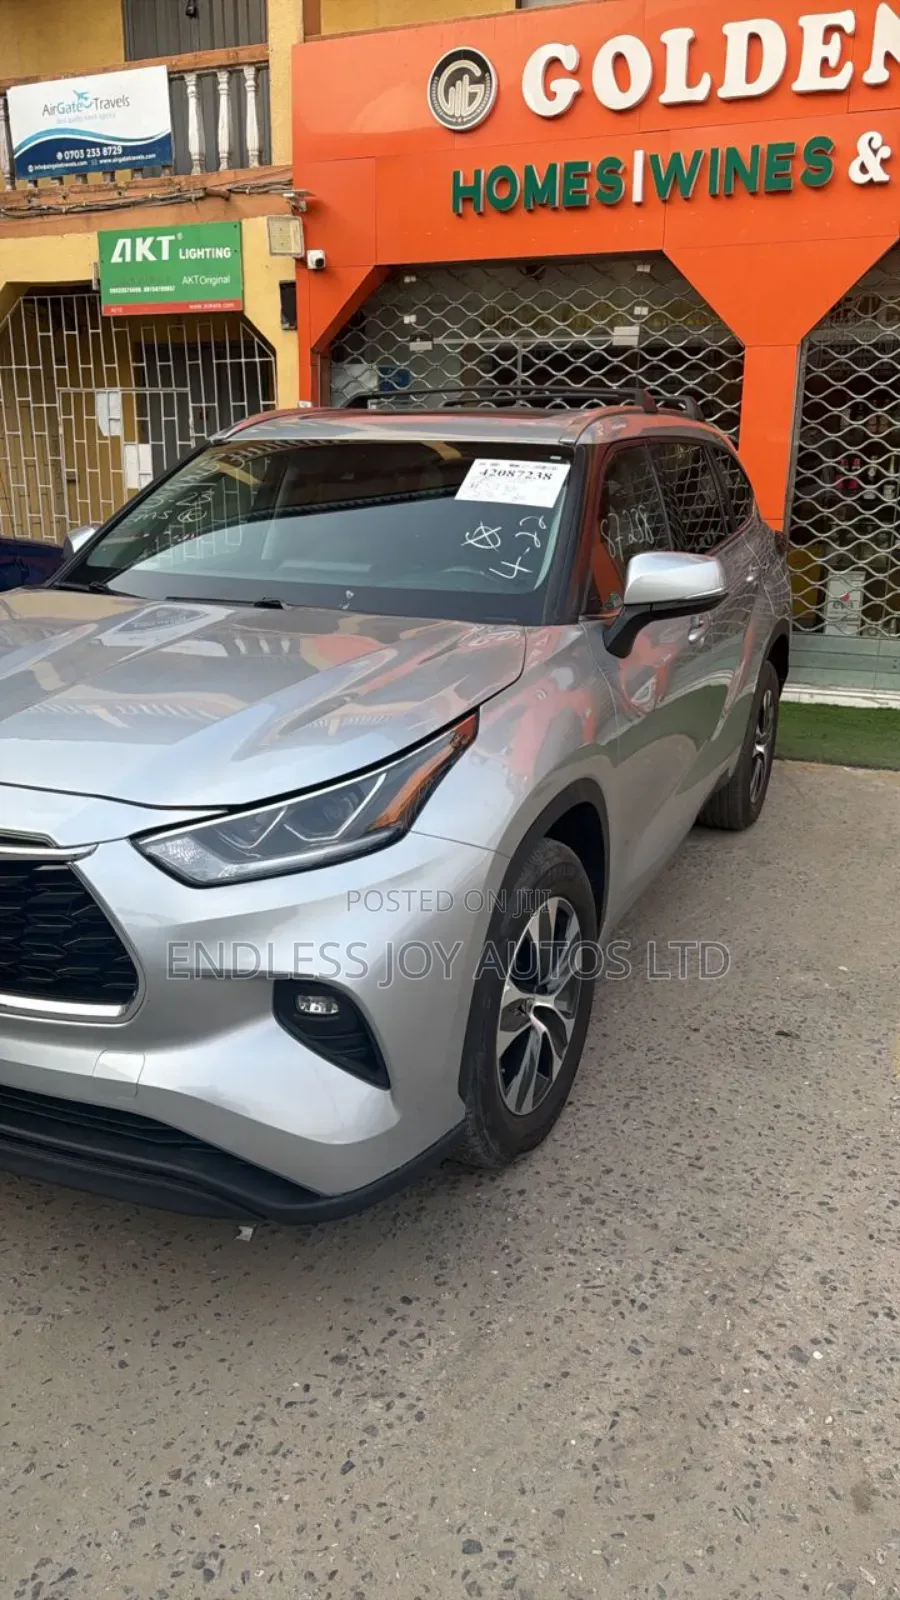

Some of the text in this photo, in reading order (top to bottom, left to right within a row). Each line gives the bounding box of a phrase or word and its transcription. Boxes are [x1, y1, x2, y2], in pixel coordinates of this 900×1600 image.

[42, 94, 131, 117] AirGate Travels
[64, 145, 123, 160] 0703 233 8729
[848, 131, 892, 185] &
[110, 235, 176, 264] AKT
[179, 247, 232, 260] LIGHTING
[479, 468, 553, 481] 42087238
